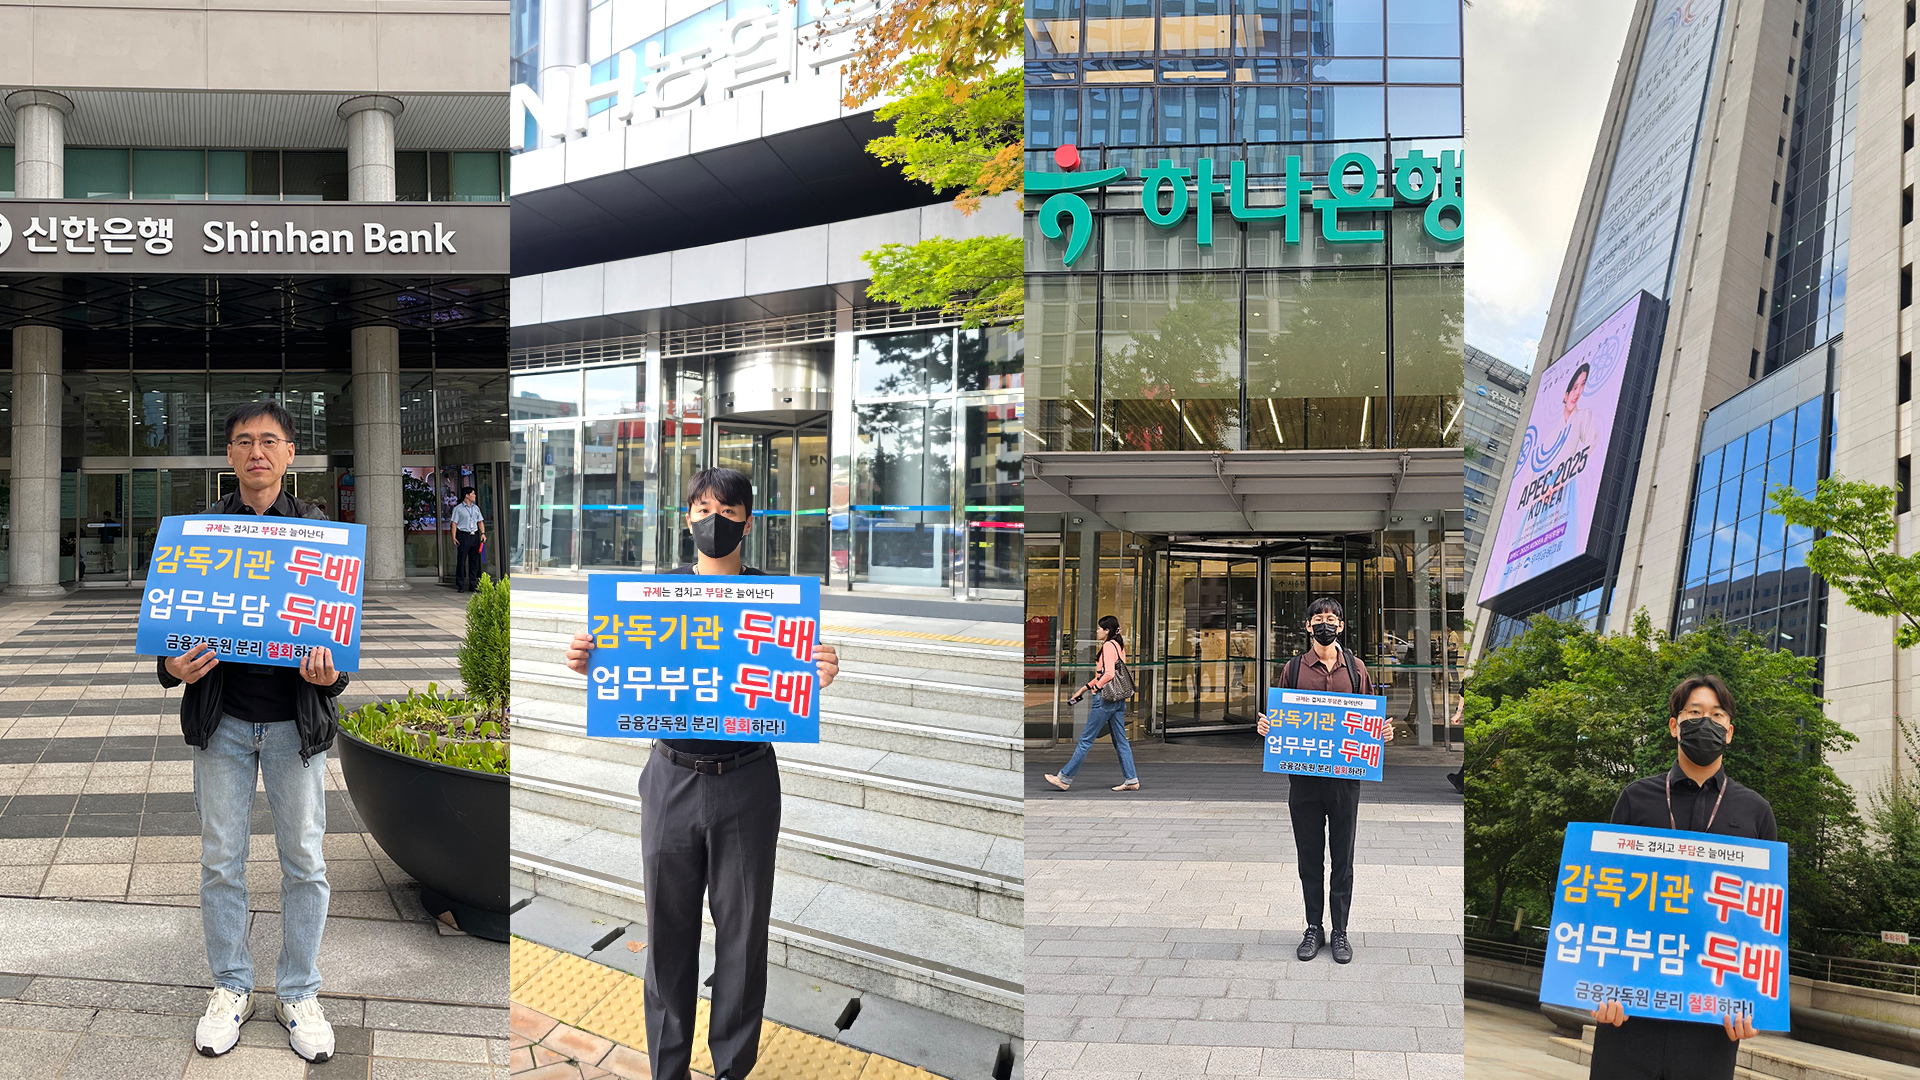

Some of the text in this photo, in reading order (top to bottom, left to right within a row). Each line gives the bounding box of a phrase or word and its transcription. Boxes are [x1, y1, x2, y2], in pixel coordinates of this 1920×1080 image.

[1637, 11, 1710, 101] APEC 2025
[1647, 48, 1689, 99] KOREA
[1655, 123, 1695, 173] APEC
[1140, 150, 1464, 247] 하나은행
[22, 216, 457, 255] 신한은행 Shinhan Bank
[1593, 191, 1673, 275] 성공적 개최를
[1596, 231, 1657, 291] 기원합니다
[1490, 390, 1522, 411] 우리금
[1517, 445, 1590, 511] APEC 2025
[1528, 486, 1564, 521] KOREA
[205, 523, 325, 539] 규제는 겹치고 부담은 늘어난다
[155, 545, 361, 595] 감독기관 두배
[643, 587, 774, 599] 규제는 겹치고 부담은 늘어난다
[148, 588, 355, 645] 업무부담 두배
[591, 610, 816, 662] 감독기관 두배
[236, 639, 263, 656] 분리
[592, 664, 814, 717] 업무부담 두배
[1295, 695, 1310, 703] 규제는
[1311, 696, 1327, 704] 겹치고
[617, 714, 785, 734] 금융감독원 분리 철회하라!
[1268, 709, 1383, 740] 감독기관 두배
[1267, 735, 1380, 768] 업무부담 두배
[1279, 761, 1366, 776] 금융감독원 분리 철회하라!
[1617, 838, 1744, 862] 규제는 겹치고 부담은 늘어난다
[1562, 865, 1784, 936] 감독기관 두배
[1554, 921, 1782, 999] 업무부담 두배
[1653, 991, 1683, 1011] 분리
